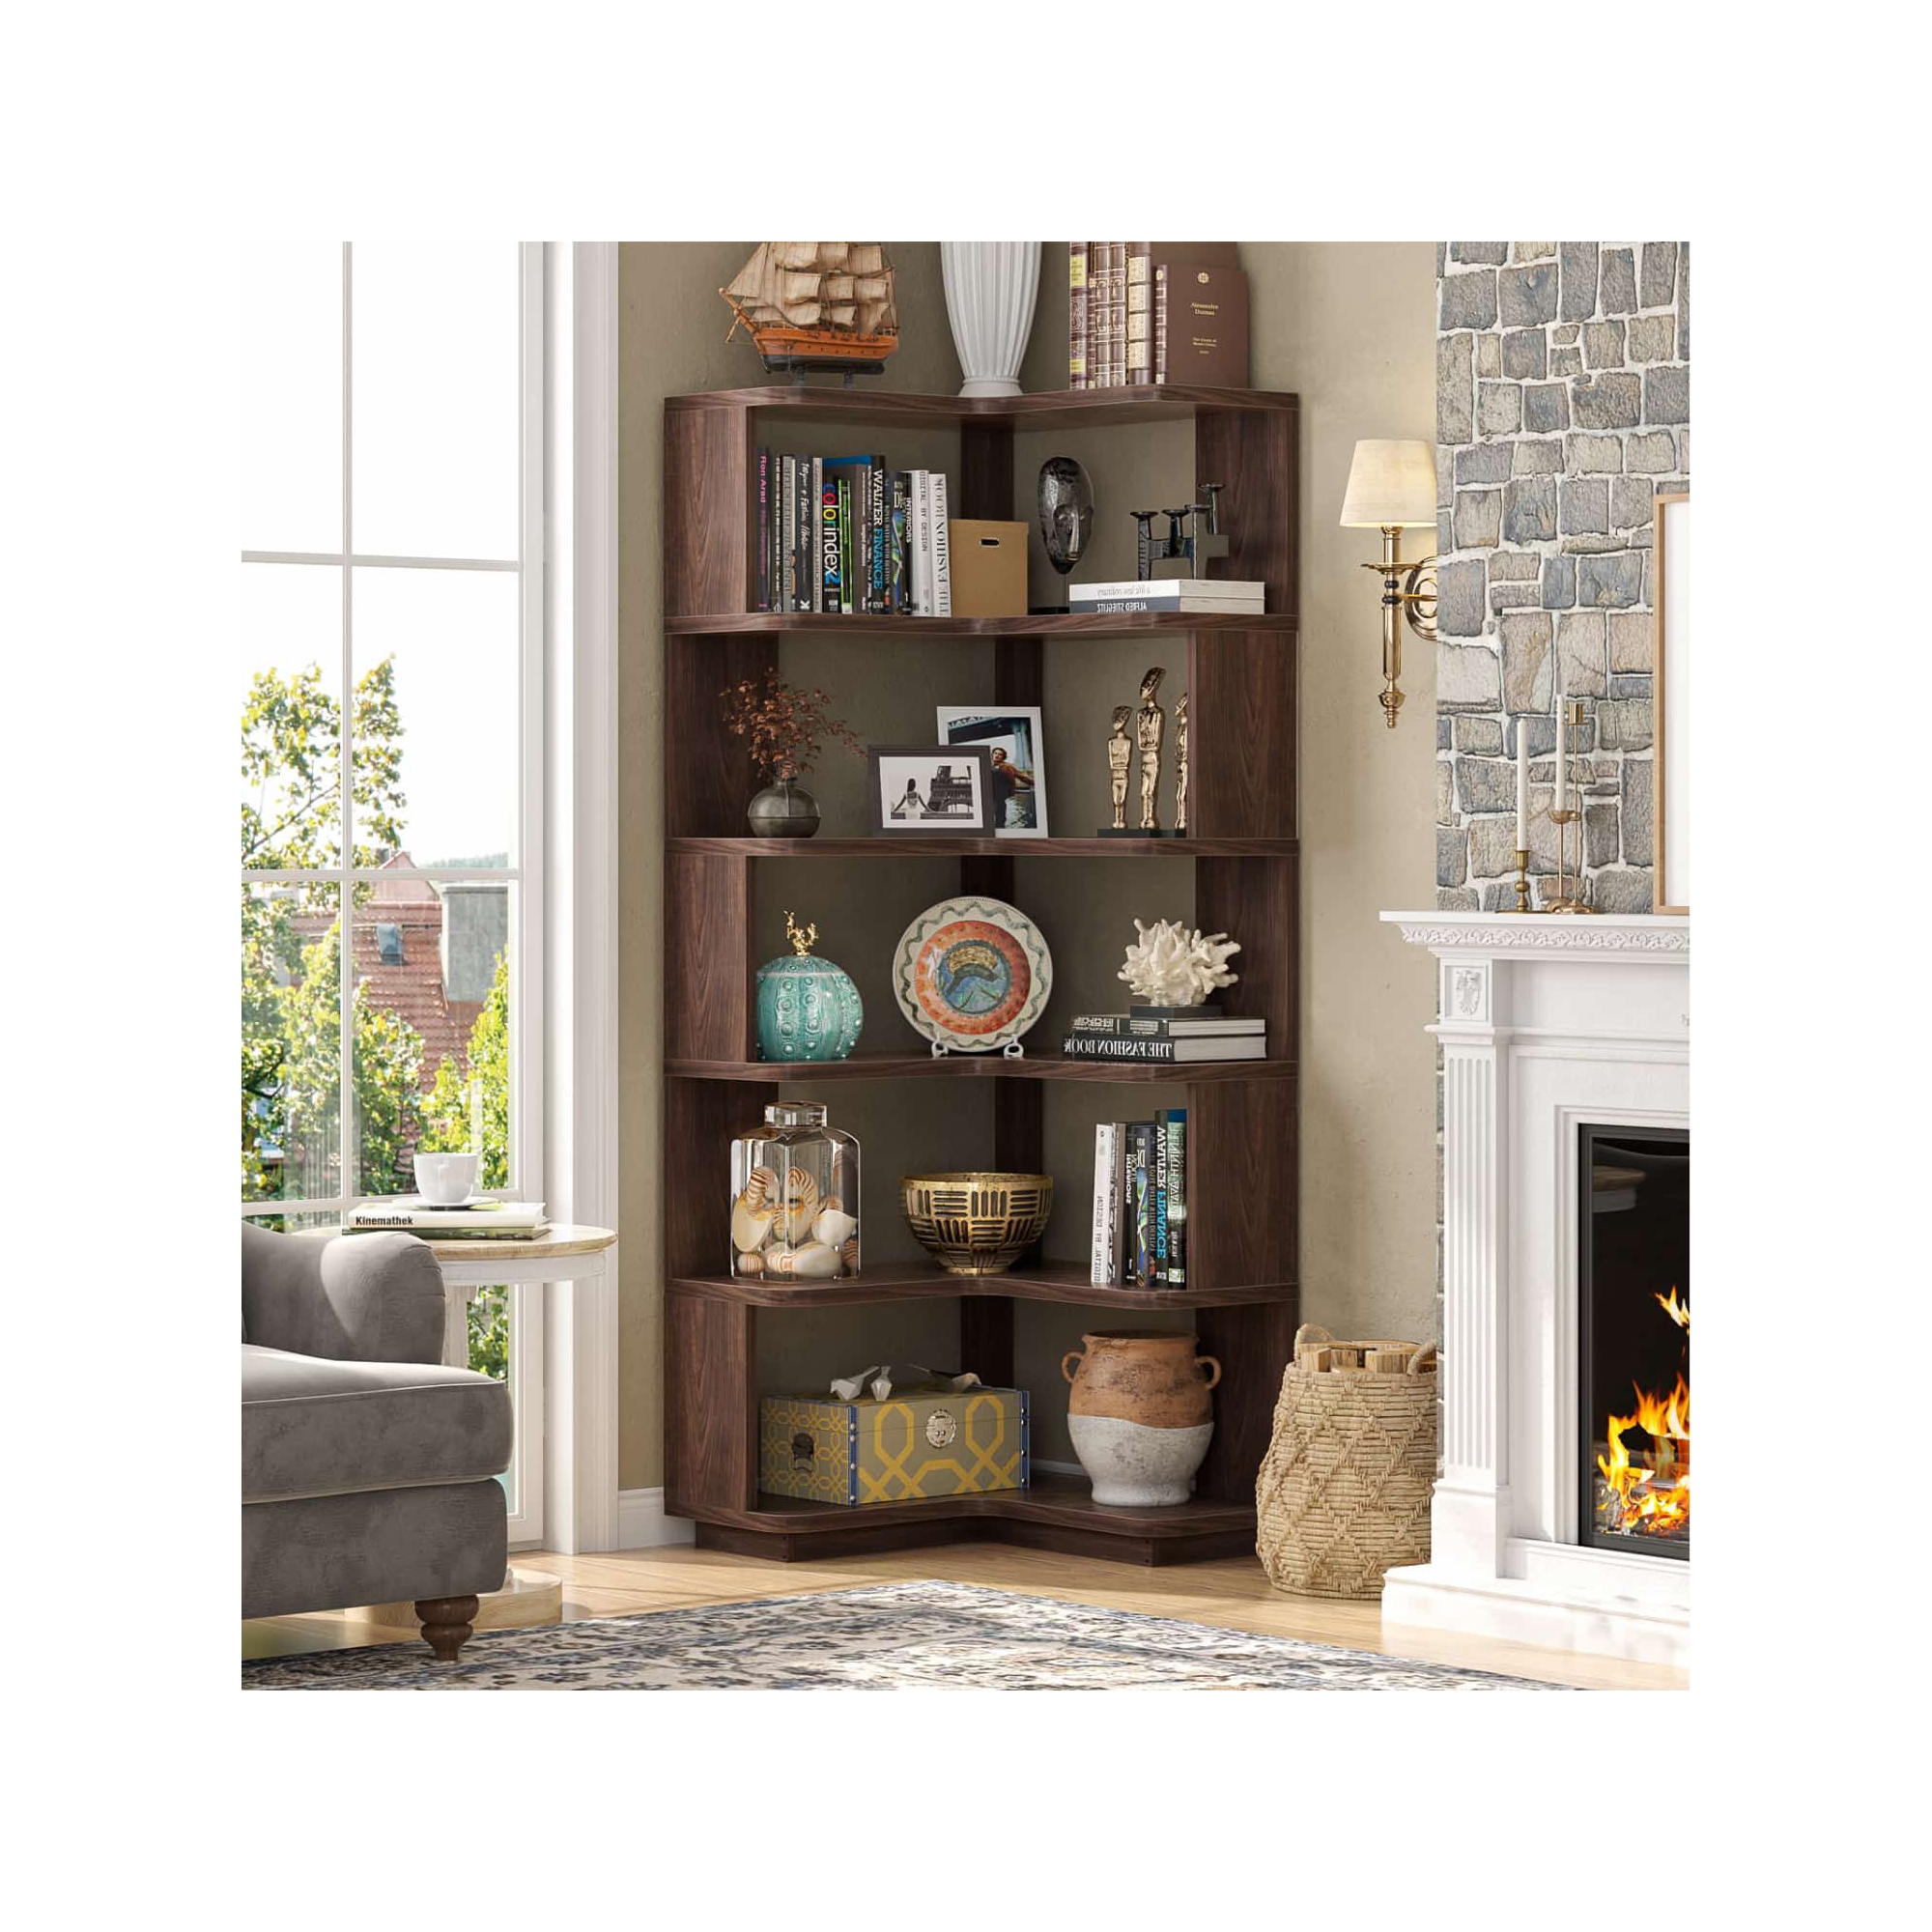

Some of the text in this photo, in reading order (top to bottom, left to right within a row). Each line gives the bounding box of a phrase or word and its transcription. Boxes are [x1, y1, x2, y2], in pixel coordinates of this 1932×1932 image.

[872, 469, 883, 526] WALTER
[921, 507, 926, 518] BY
[873, 527, 883, 590] FINANCE
[935, 522, 948, 582] FASHION
[355, 1215, 414, 1226] Kinemathek
